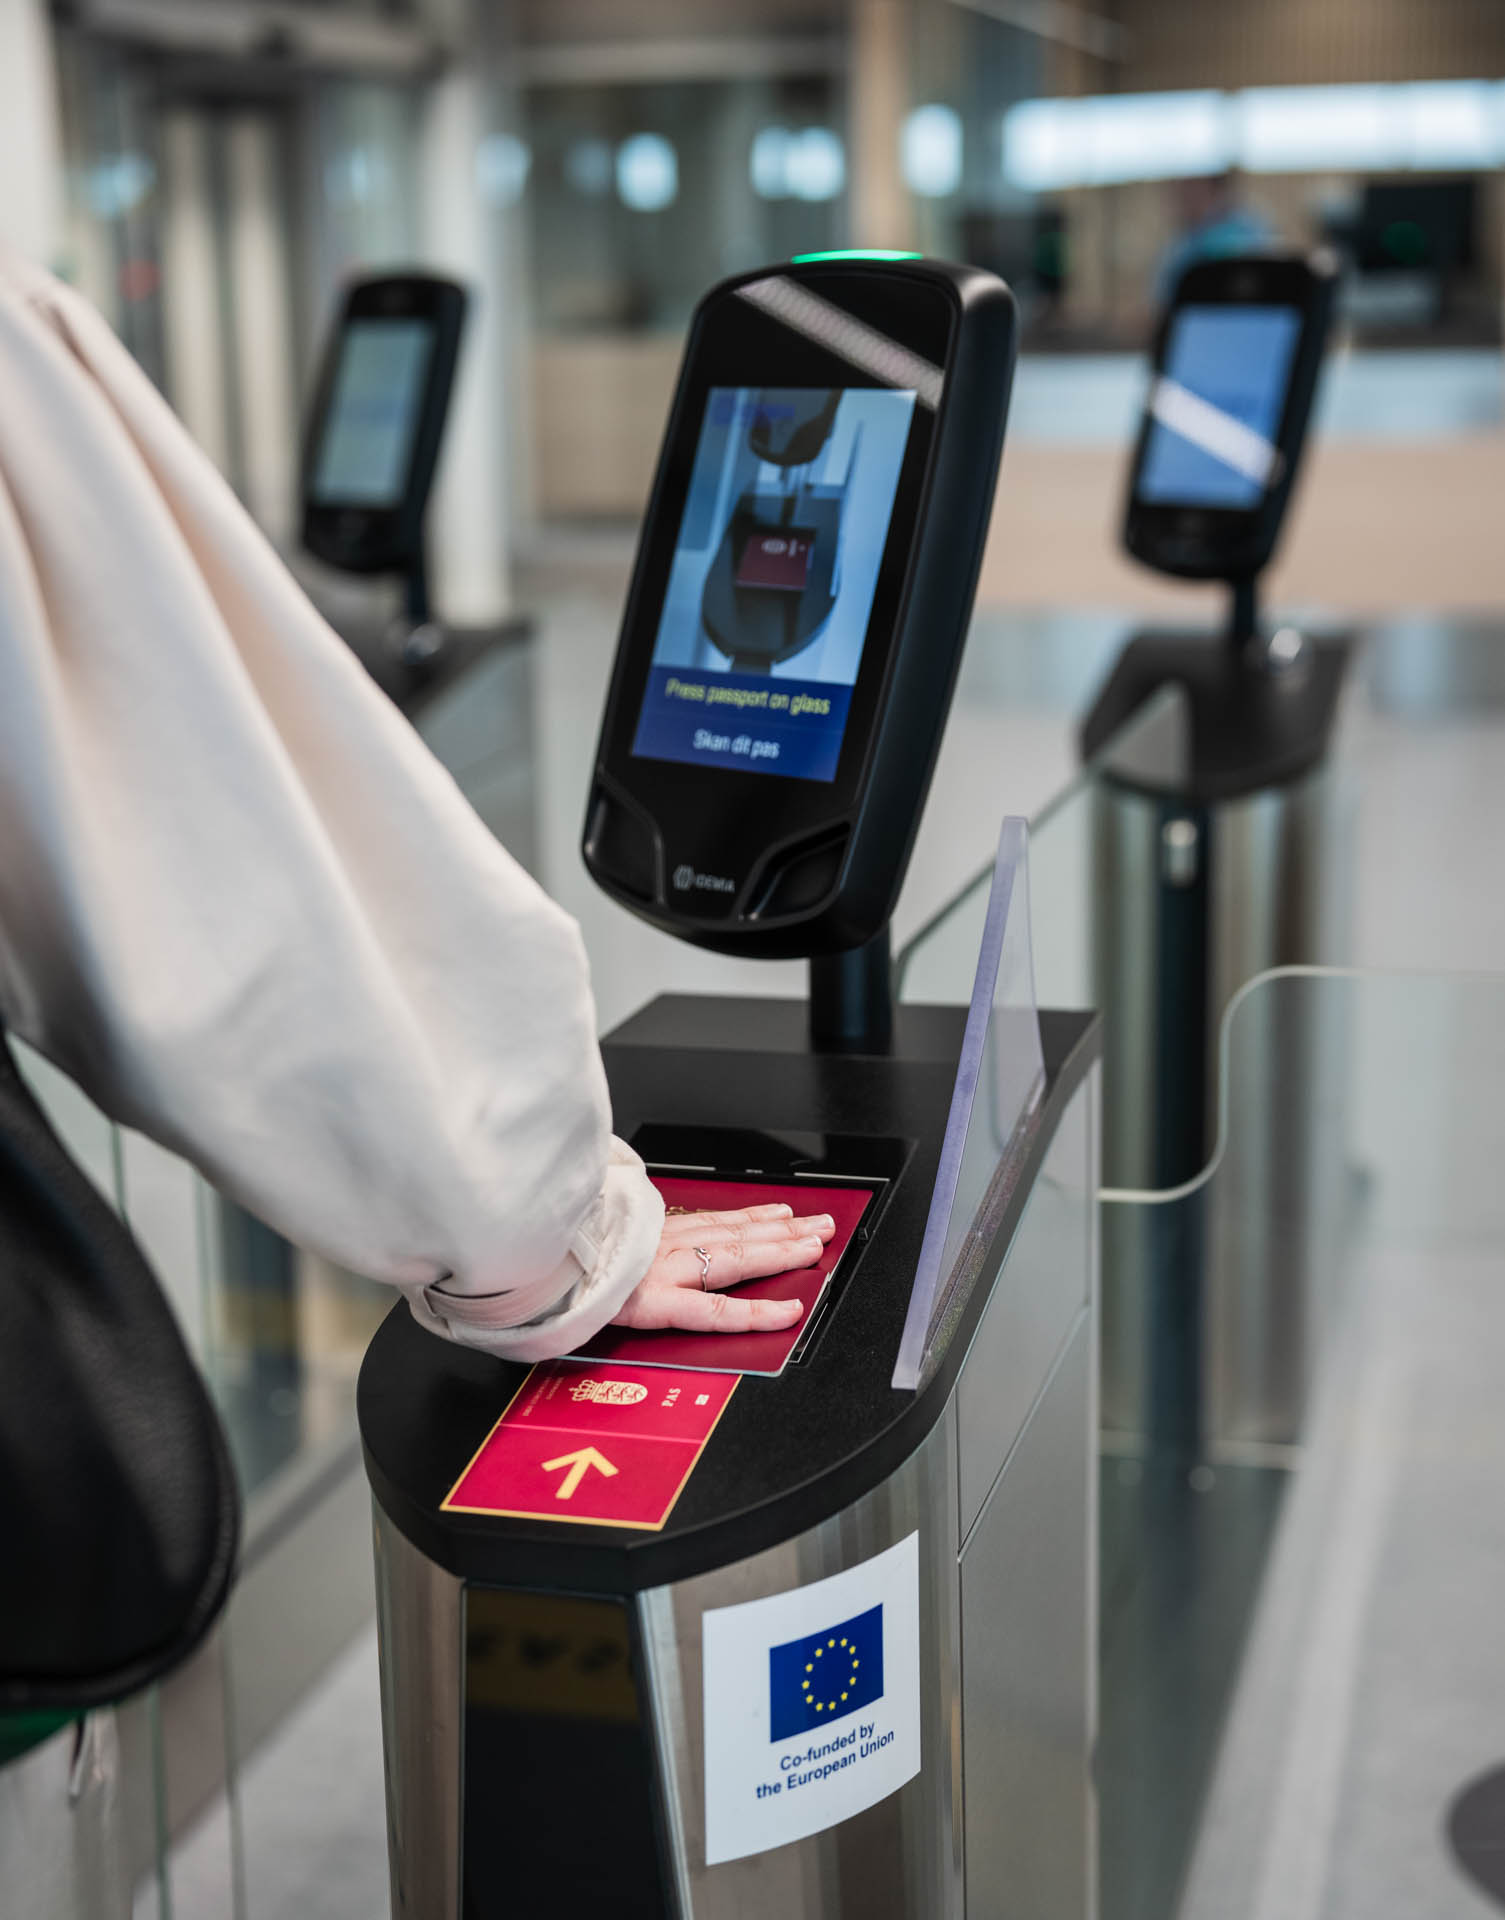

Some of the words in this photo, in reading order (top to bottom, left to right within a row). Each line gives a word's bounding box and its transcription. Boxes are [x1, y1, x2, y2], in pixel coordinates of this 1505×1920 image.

[665, 678, 705, 701] Press
[705, 686, 769, 708] passport
[769, 693, 790, 709] on
[790, 693, 831, 716] glass
[693, 728, 732, 751] Skan
[731, 734, 752, 756] dit
[751, 740, 780, 759] pas
[661, 1388, 681, 1407] PAS
[756, 1781, 782, 1799] the
[787, 1751, 857, 1790] European
[860, 1730, 895, 1758] Union
[780, 1728, 856, 1771] Co-funded
[859, 1721, 876, 1739] by
